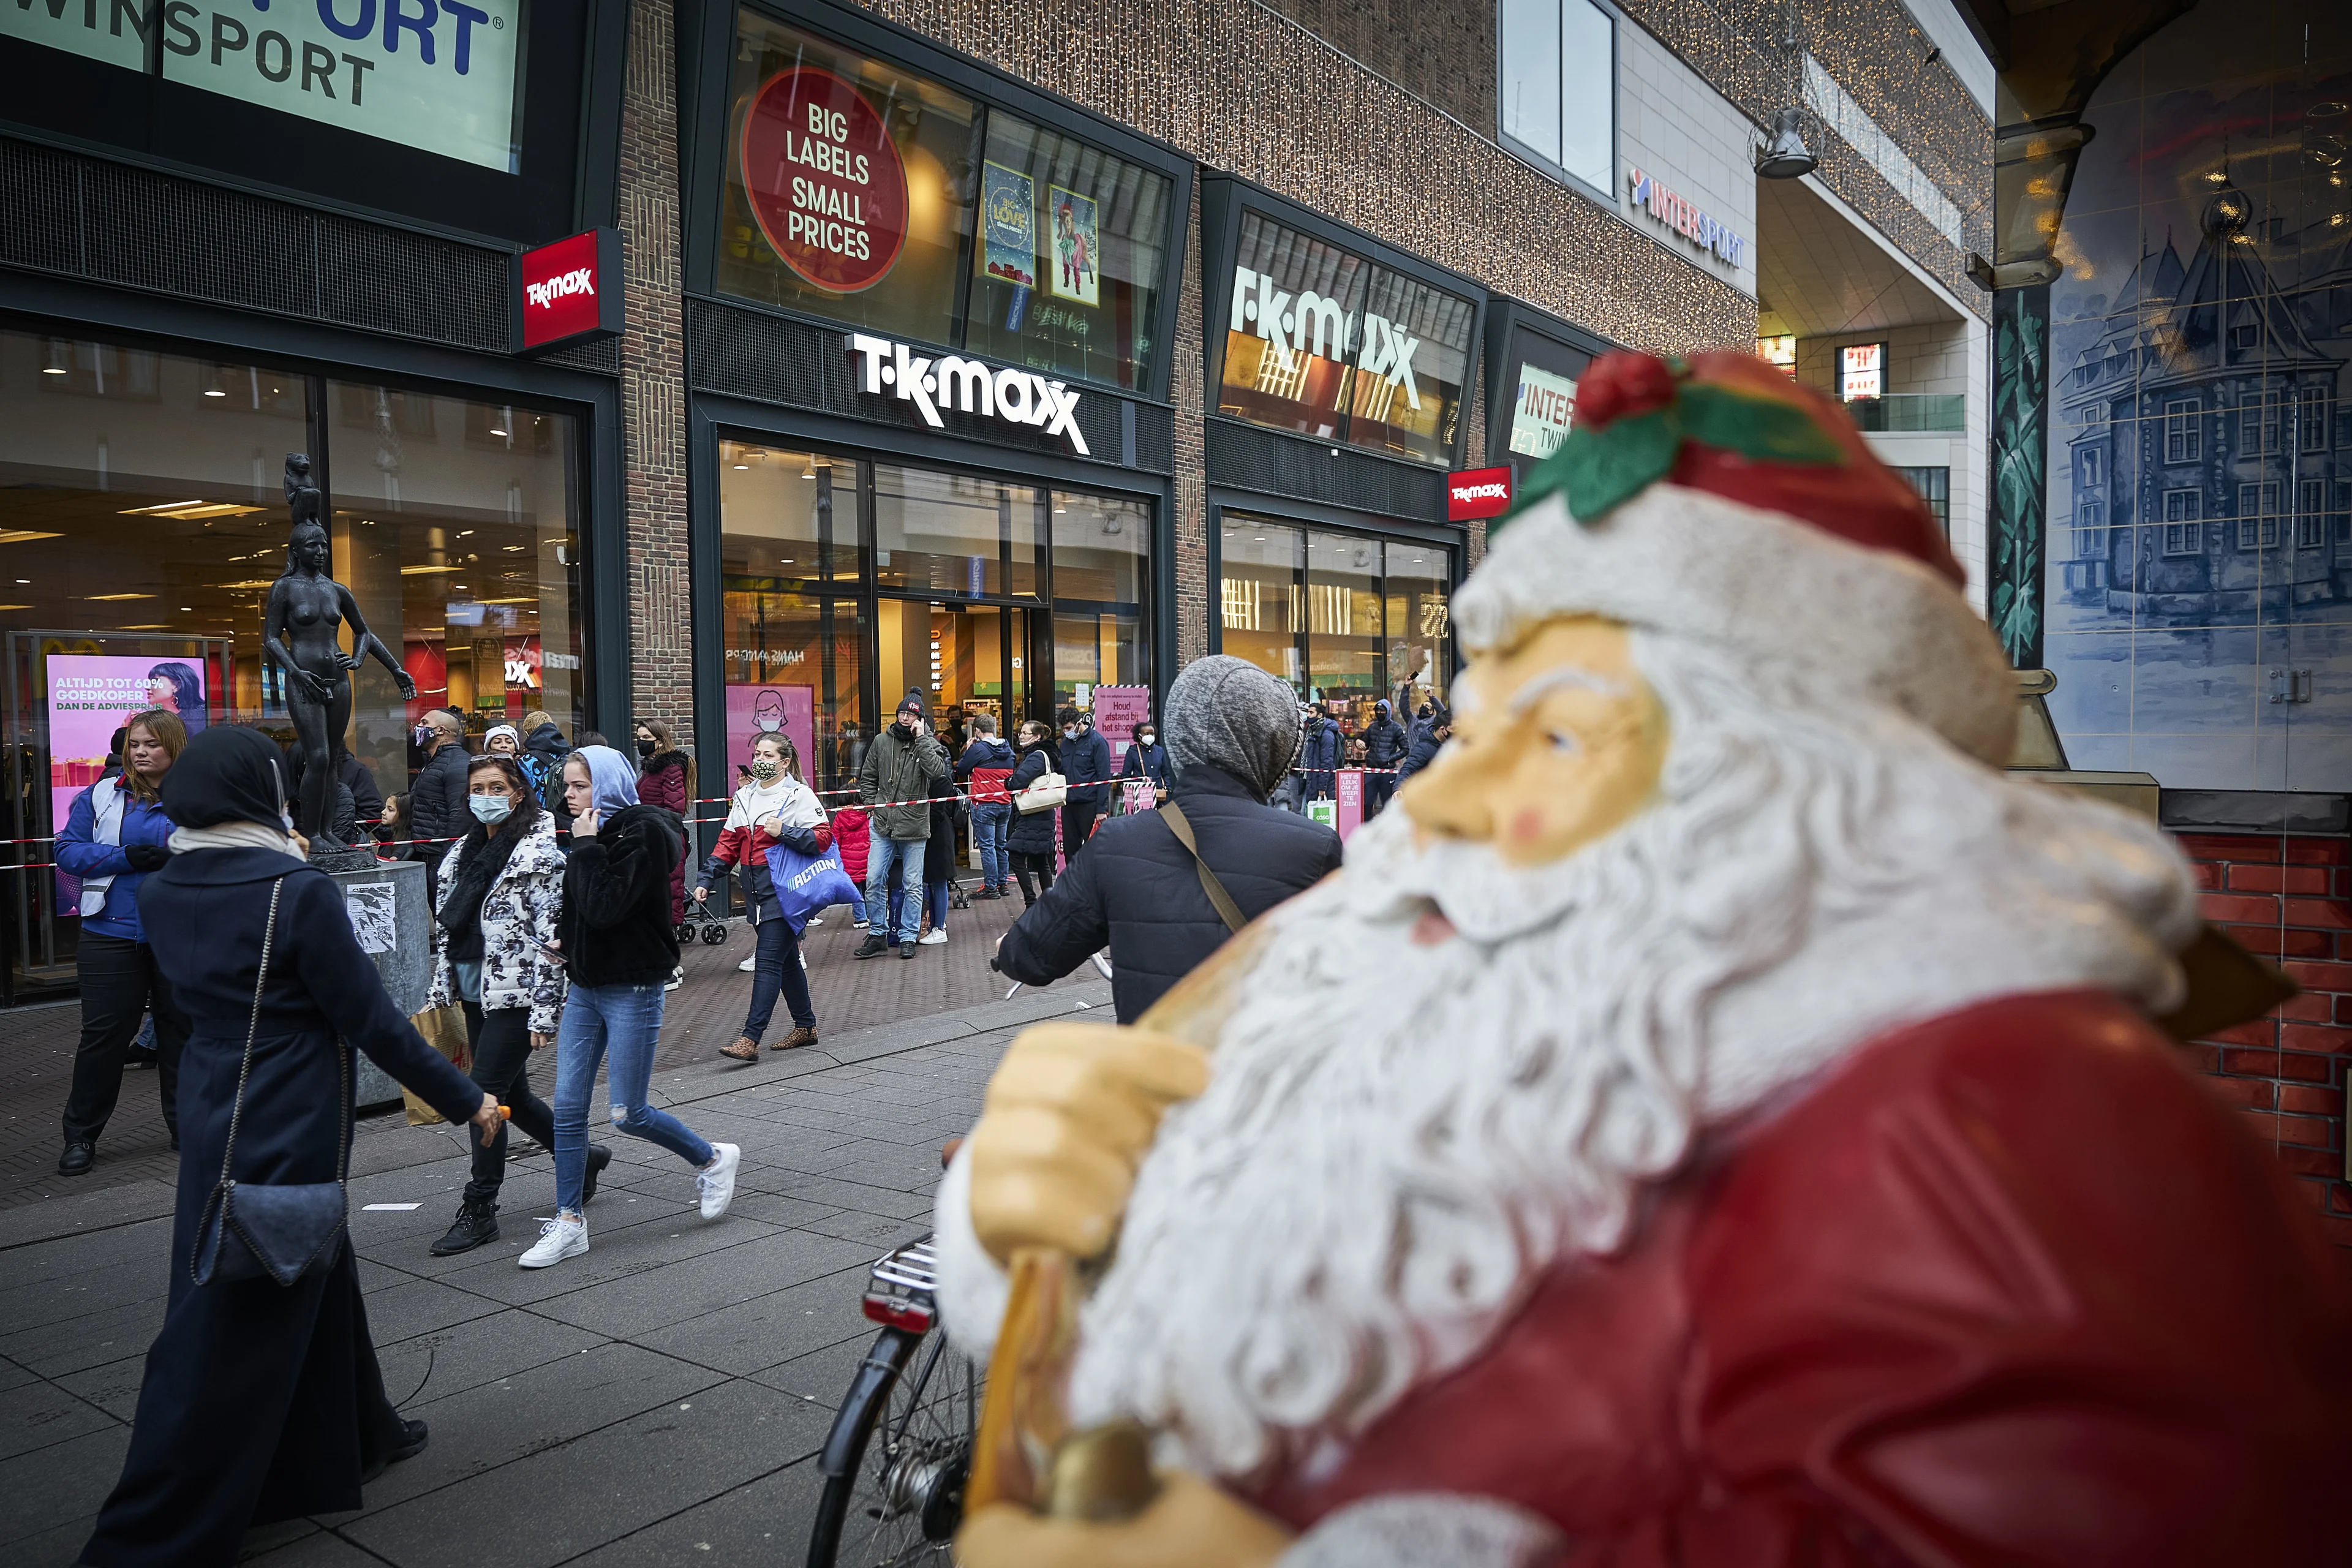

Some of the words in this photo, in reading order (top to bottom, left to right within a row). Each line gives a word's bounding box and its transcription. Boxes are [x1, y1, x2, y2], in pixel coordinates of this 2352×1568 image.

[808, 102, 848, 143] BIG
[786, 130, 869, 185] LABELS
[792, 176, 865, 226] SMALL
[1003, 197, 1016, 209] BIG
[993, 203, 1025, 229] LOVE
[1650, 178, 1744, 270] INTERSPORT
[788, 210, 870, 261] PRICES
[55, 677, 104, 688] ALTIJD
[106, 678, 132, 688] TOT
[134, 678, 164, 689] 60%
[56, 690, 143, 701] GOEDKOPER
[1105, 712, 1129, 721] afstand
[1113, 701, 1131, 710] Houd
[1102, 723, 1114, 732] het
[794, 858, 837, 889] ACTION
